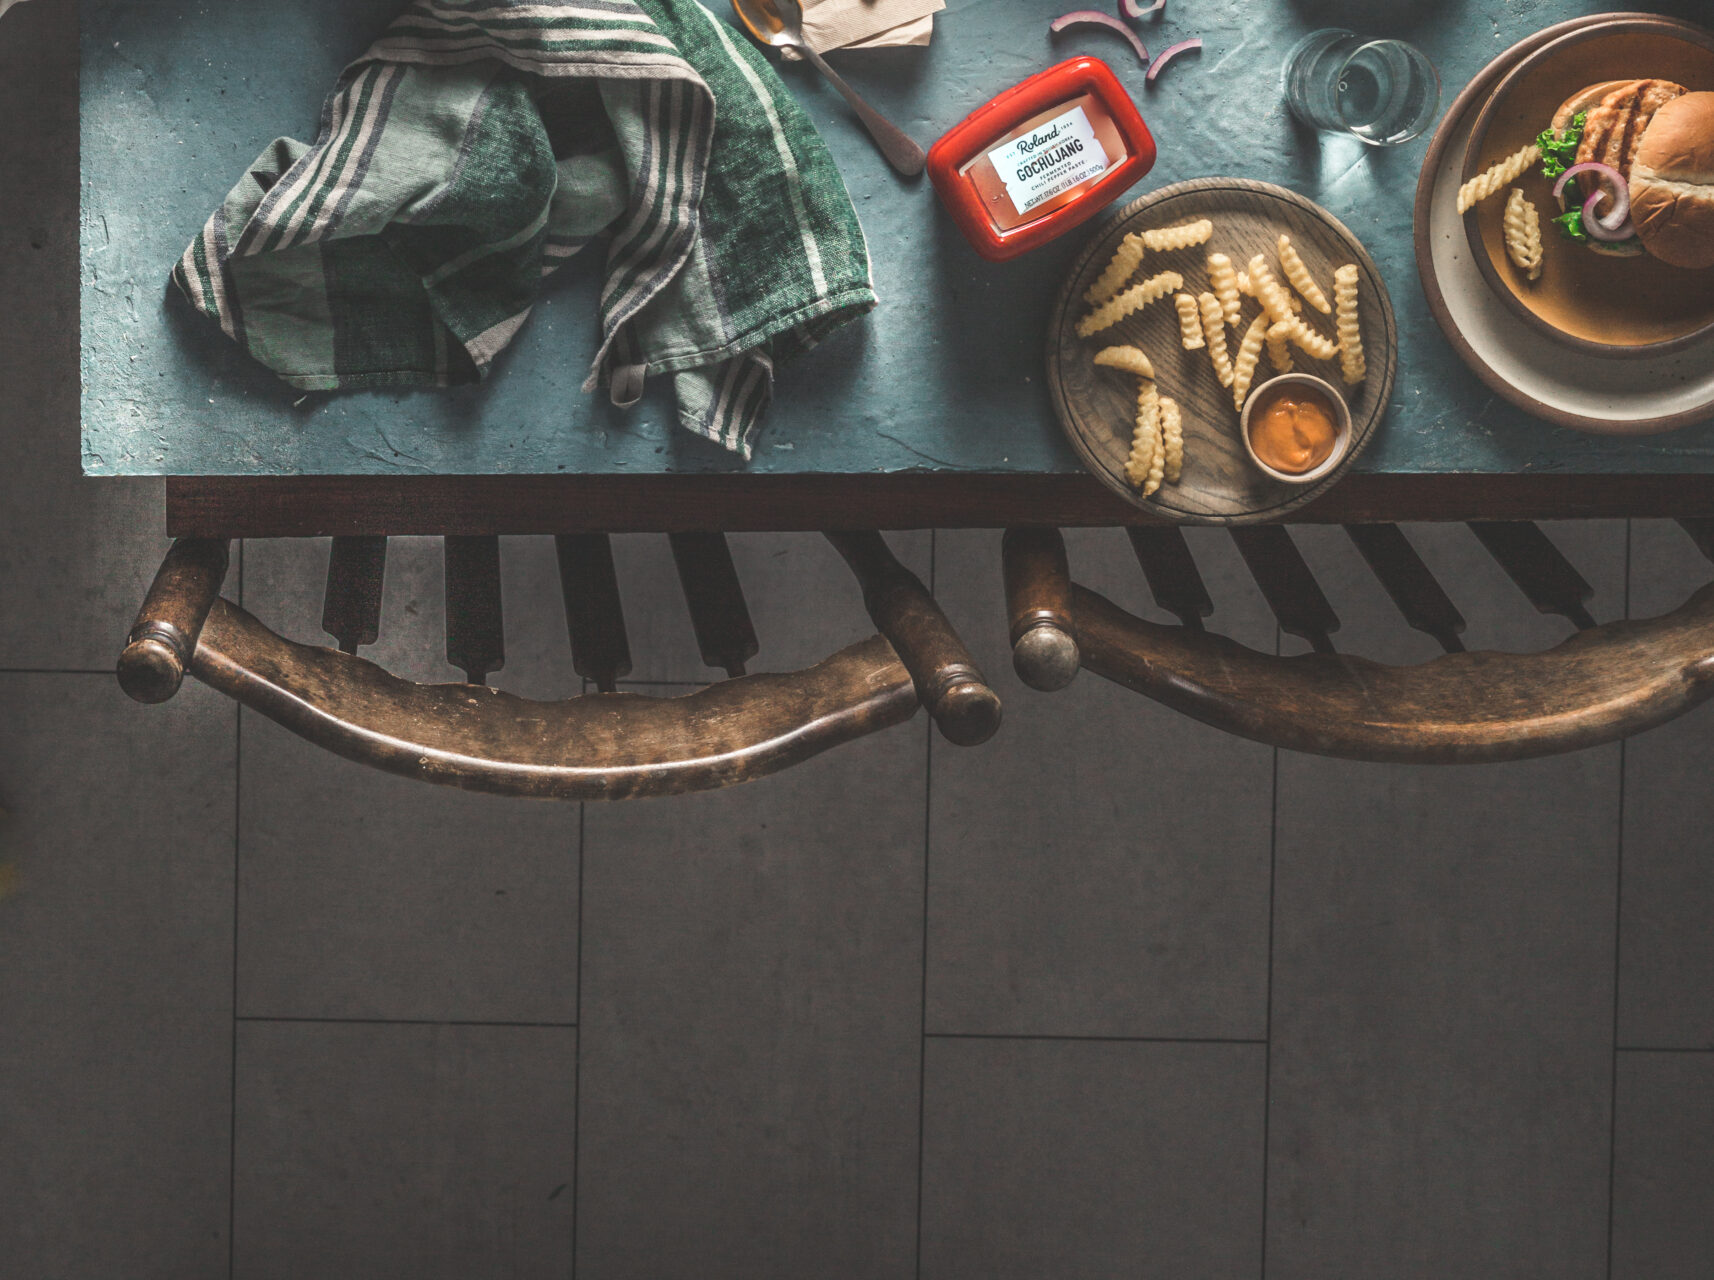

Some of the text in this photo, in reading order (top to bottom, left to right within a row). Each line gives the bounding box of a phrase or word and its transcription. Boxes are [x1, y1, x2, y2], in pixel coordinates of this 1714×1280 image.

[1016, 124, 1060, 155] Roland
[1016, 139, 1083, 181] GOCHUJANG
[1031, 160, 1085, 191] CHILI PEPPER PASTE
[1040, 161, 1071, 180] FERMENTED
